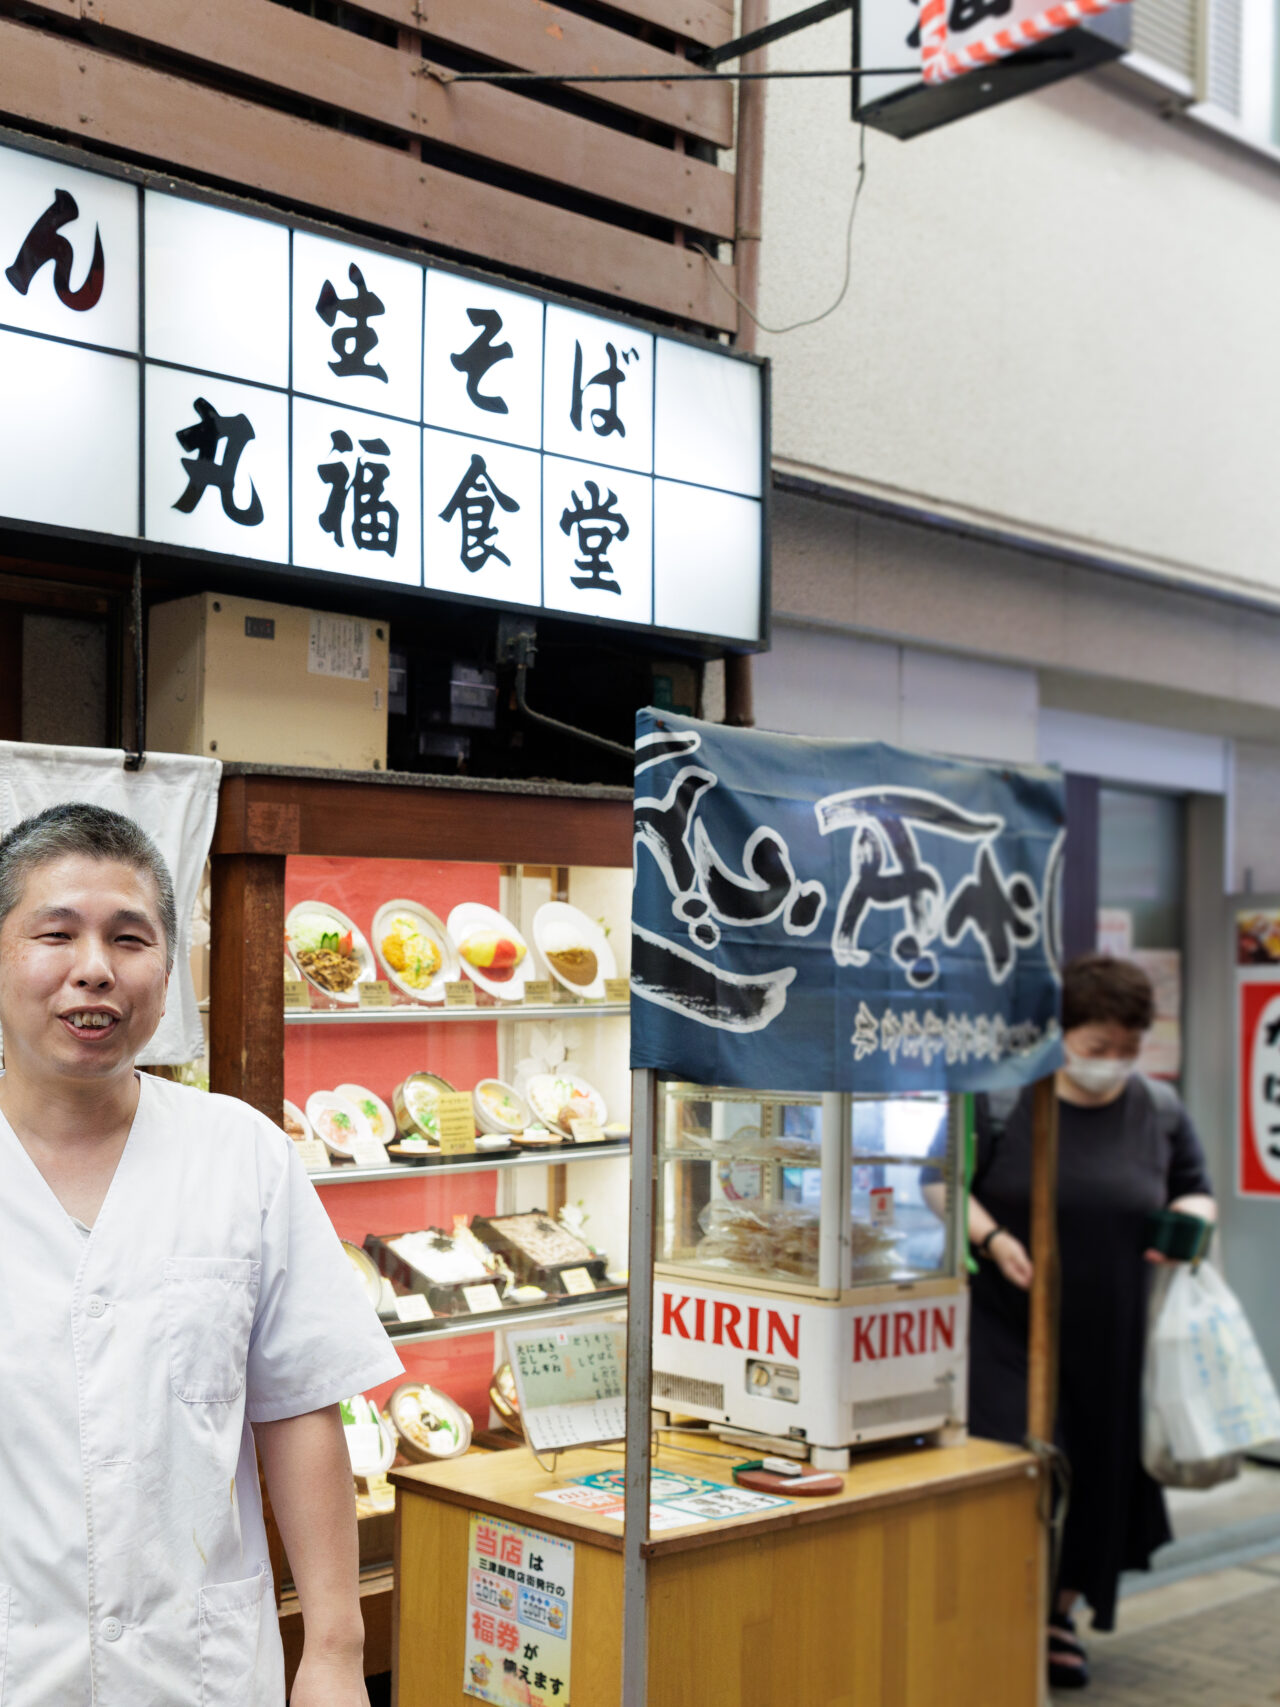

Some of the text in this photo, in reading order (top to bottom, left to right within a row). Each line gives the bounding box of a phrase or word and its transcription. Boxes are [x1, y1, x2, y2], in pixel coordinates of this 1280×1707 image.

[315, 262, 639, 438] 生そば
[171, 396, 630, 596] 丸福食堂
[662, 1292, 801, 1360] KIRIN
[852, 1306, 956, 1363] KIRIN
